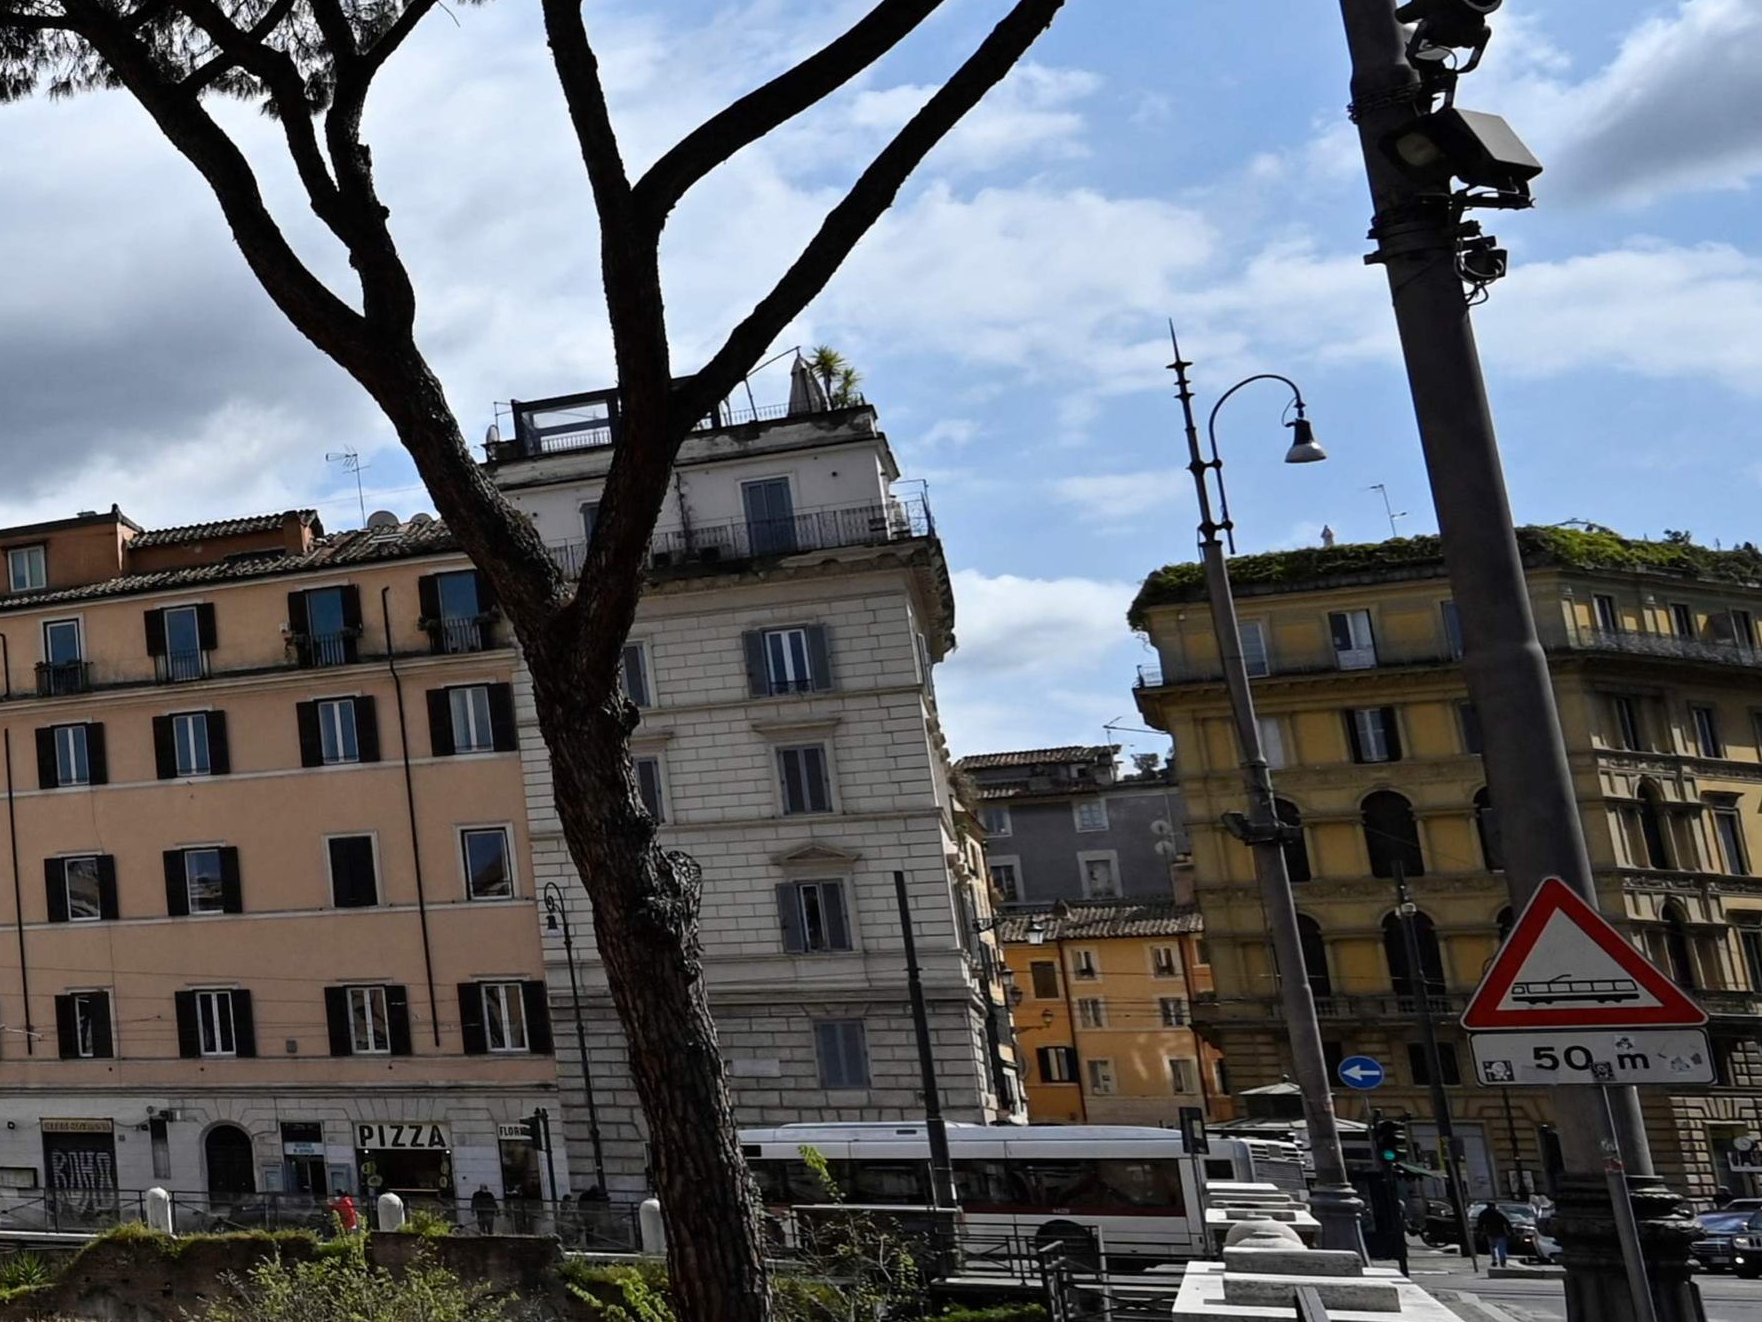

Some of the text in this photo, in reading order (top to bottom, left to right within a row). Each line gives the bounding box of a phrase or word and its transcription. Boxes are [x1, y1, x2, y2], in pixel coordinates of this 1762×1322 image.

[1532, 1045, 1650, 1072] 50 m
[359, 1124, 446, 1148] PIZZA
